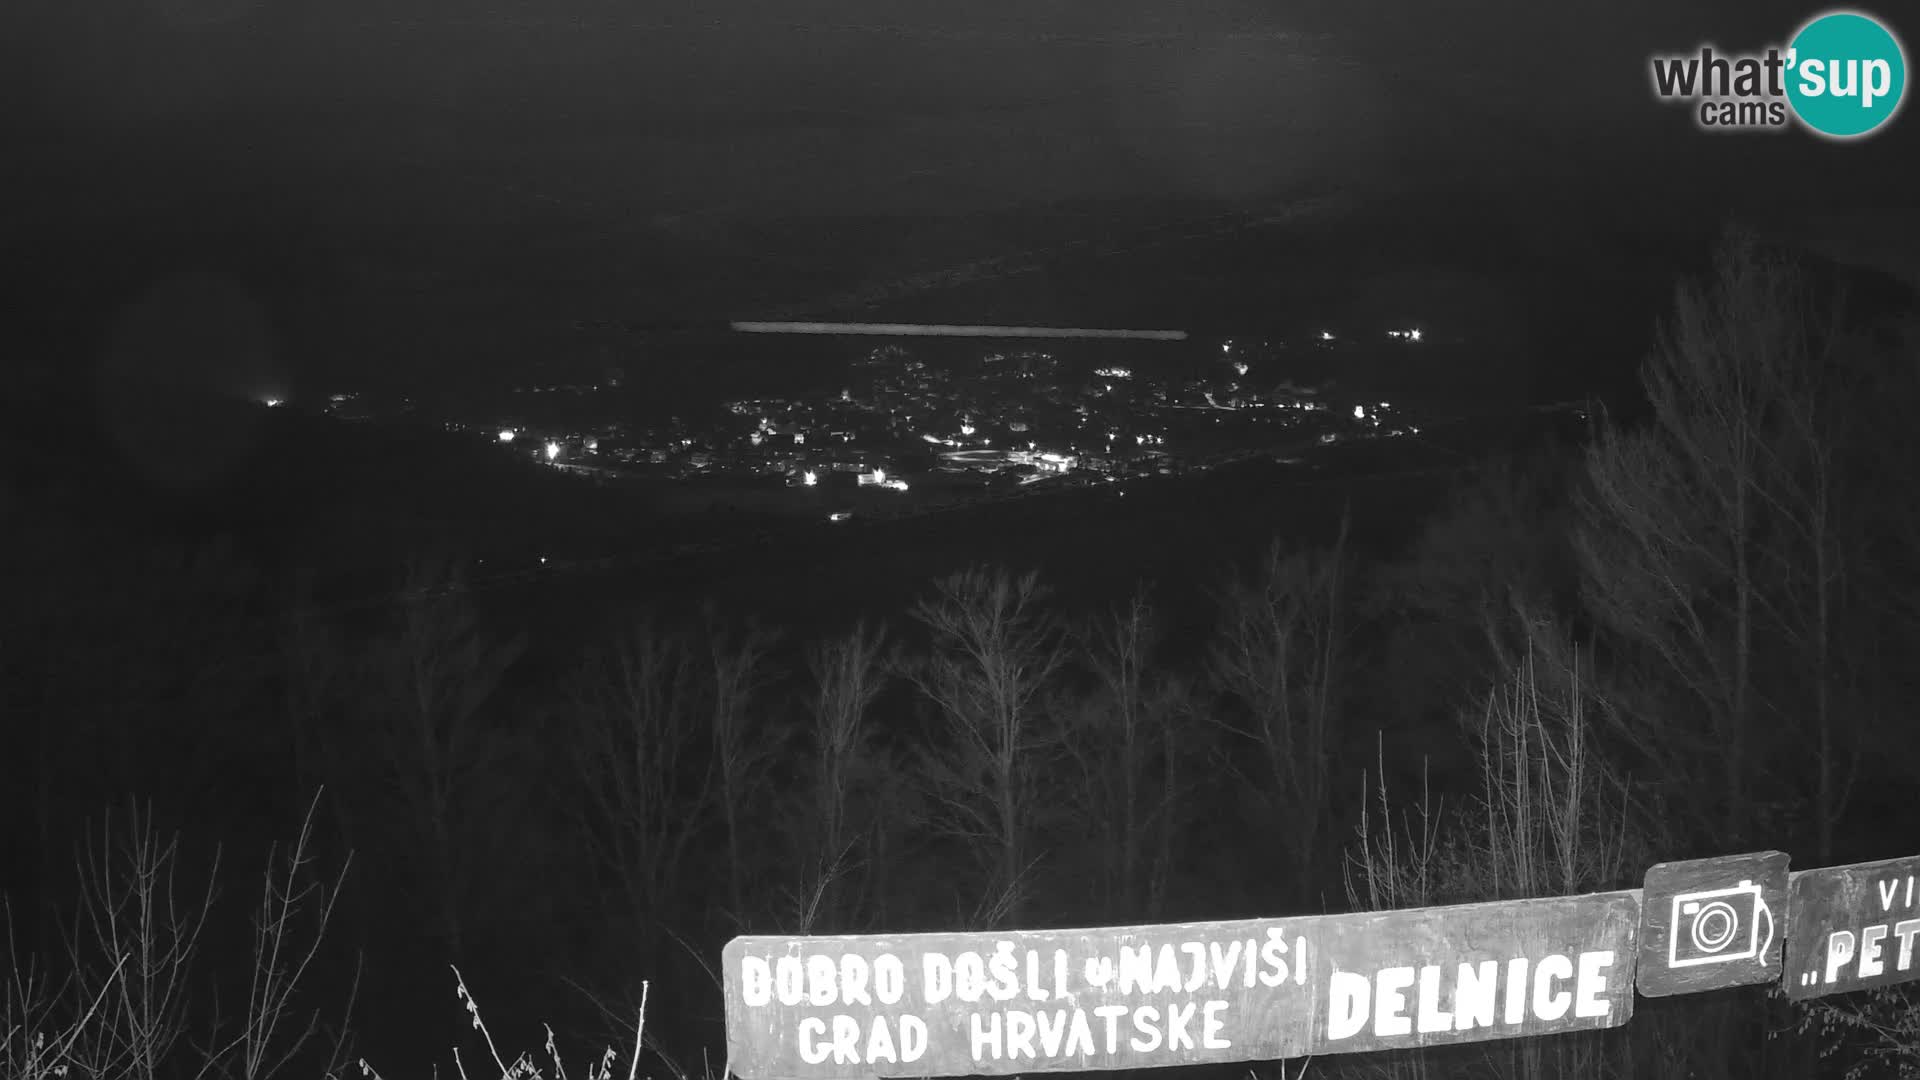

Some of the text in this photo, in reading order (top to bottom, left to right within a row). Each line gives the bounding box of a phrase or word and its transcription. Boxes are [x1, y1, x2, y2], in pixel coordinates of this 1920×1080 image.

[1879, 875, 1920, 911] VI
[742, 953, 904, 1007] DOBRO
[923, 940, 1073, 1004] DOŠLI
[1327, 950, 1615, 1040] DELNICE
[799, 1000, 1232, 1065] GRAD HRVATSKE
